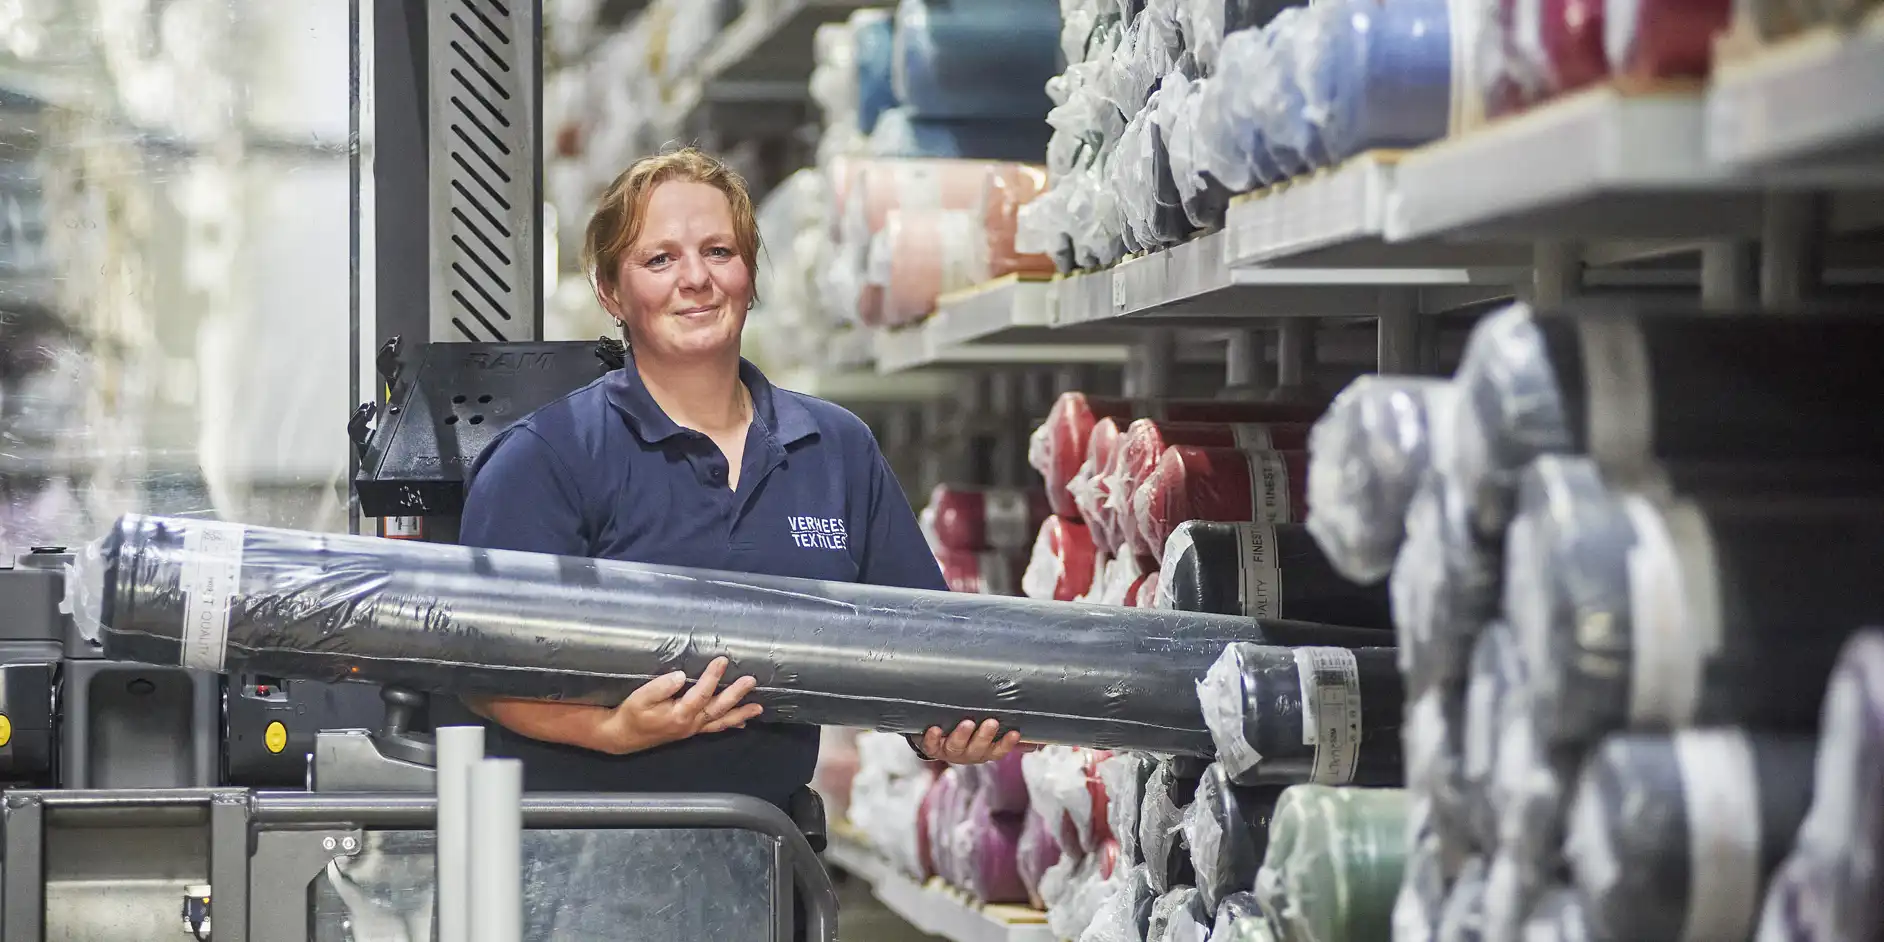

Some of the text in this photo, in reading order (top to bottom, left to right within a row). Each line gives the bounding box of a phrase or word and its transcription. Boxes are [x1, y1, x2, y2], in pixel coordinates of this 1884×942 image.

[464, 352, 557, 370] RAM
[787, 516, 845, 532] VERHEES
[791, 533, 847, 550] TEXTILES
[1251, 529, 1268, 618] UALITY FINEST
